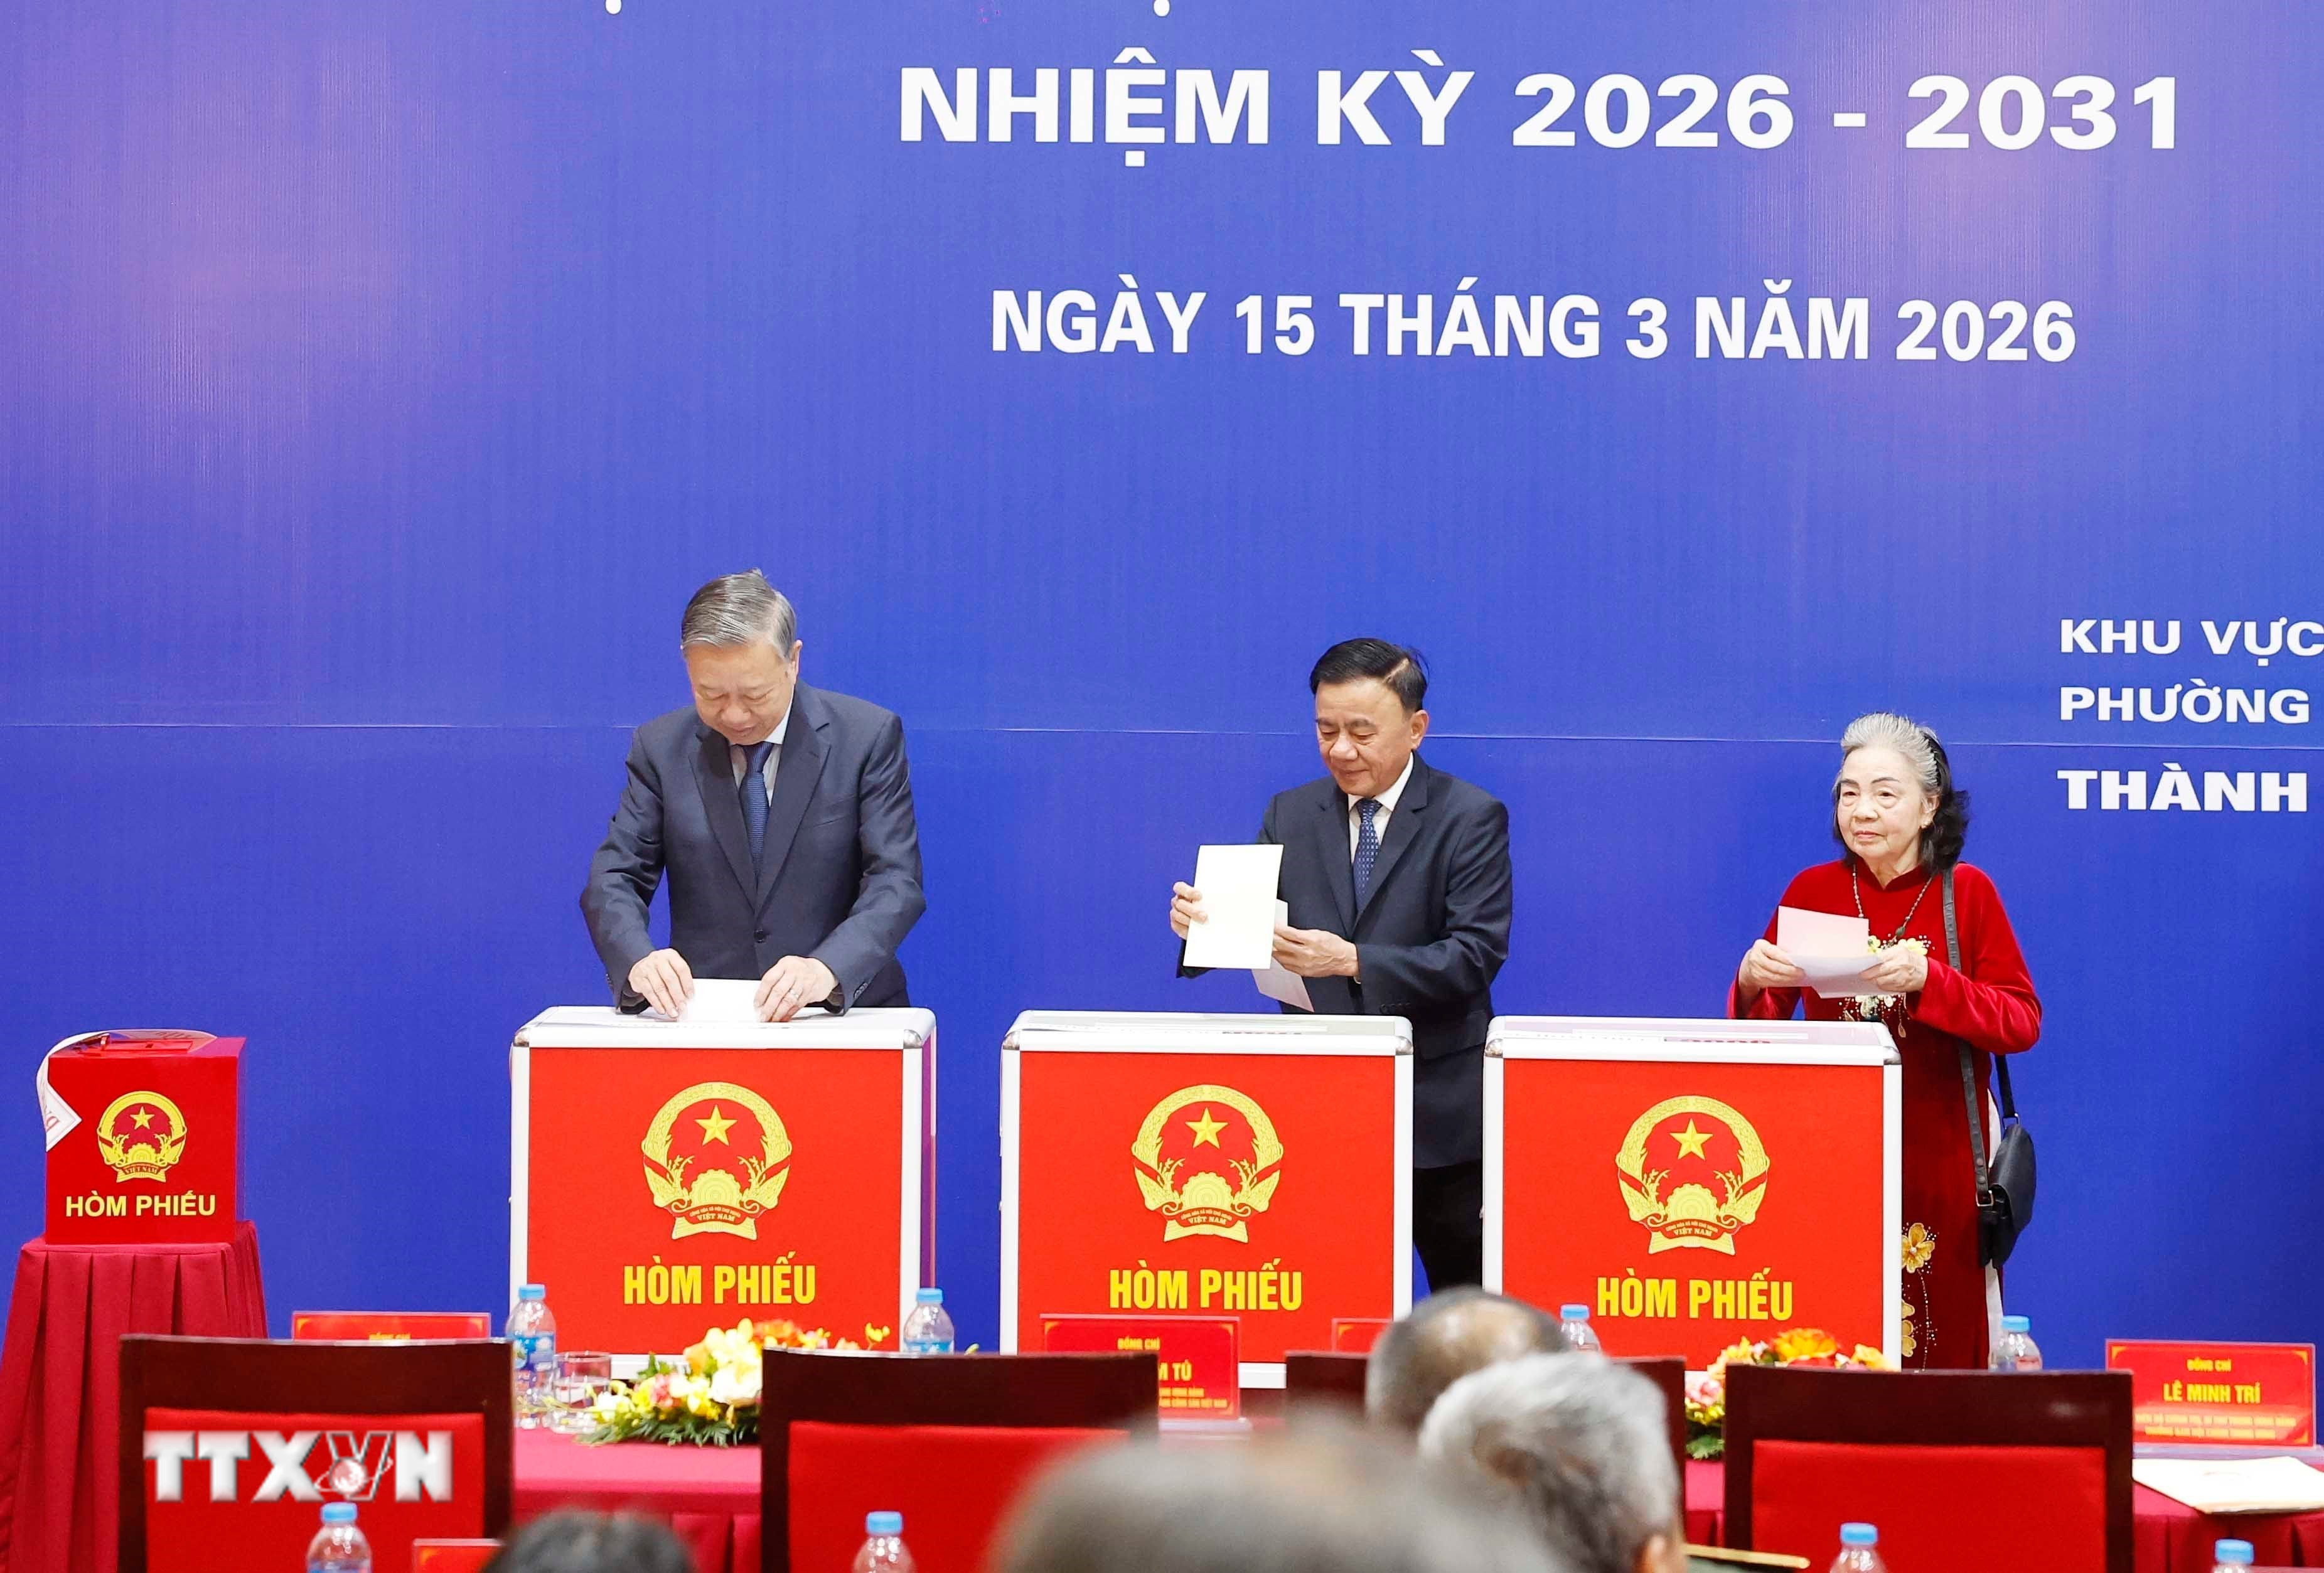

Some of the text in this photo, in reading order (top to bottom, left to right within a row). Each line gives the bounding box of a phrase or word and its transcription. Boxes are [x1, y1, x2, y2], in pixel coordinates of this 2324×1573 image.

[900, 46, 2176, 168] NHIỆM KỲ 2026 - 2031
[992, 273, 2076, 363] NGÀY 15 THÁNG 3 NĂM 2026
[2060, 616, 2324, 667] KHU VỰC
[2060, 678, 2310, 724] PHƯỜNG
[2057, 762, 2308, 813] THÀNH
[66, 1190, 215, 1217] HÒM PHIẾU
[717, 1213, 735, 1222] NAM
[1209, 1216, 1226, 1225] NAM
[1694, 1228, 1712, 1237] NAM
[624, 1251, 816, 1304] HÒM PHIẾU
[1110, 1257, 1302, 1311] HÒM PHIẾU
[1597, 1267, 1792, 1321] HÒM PHIẾU
[2163, 1379, 2261, 1404] LÊ MINH TRÍ
